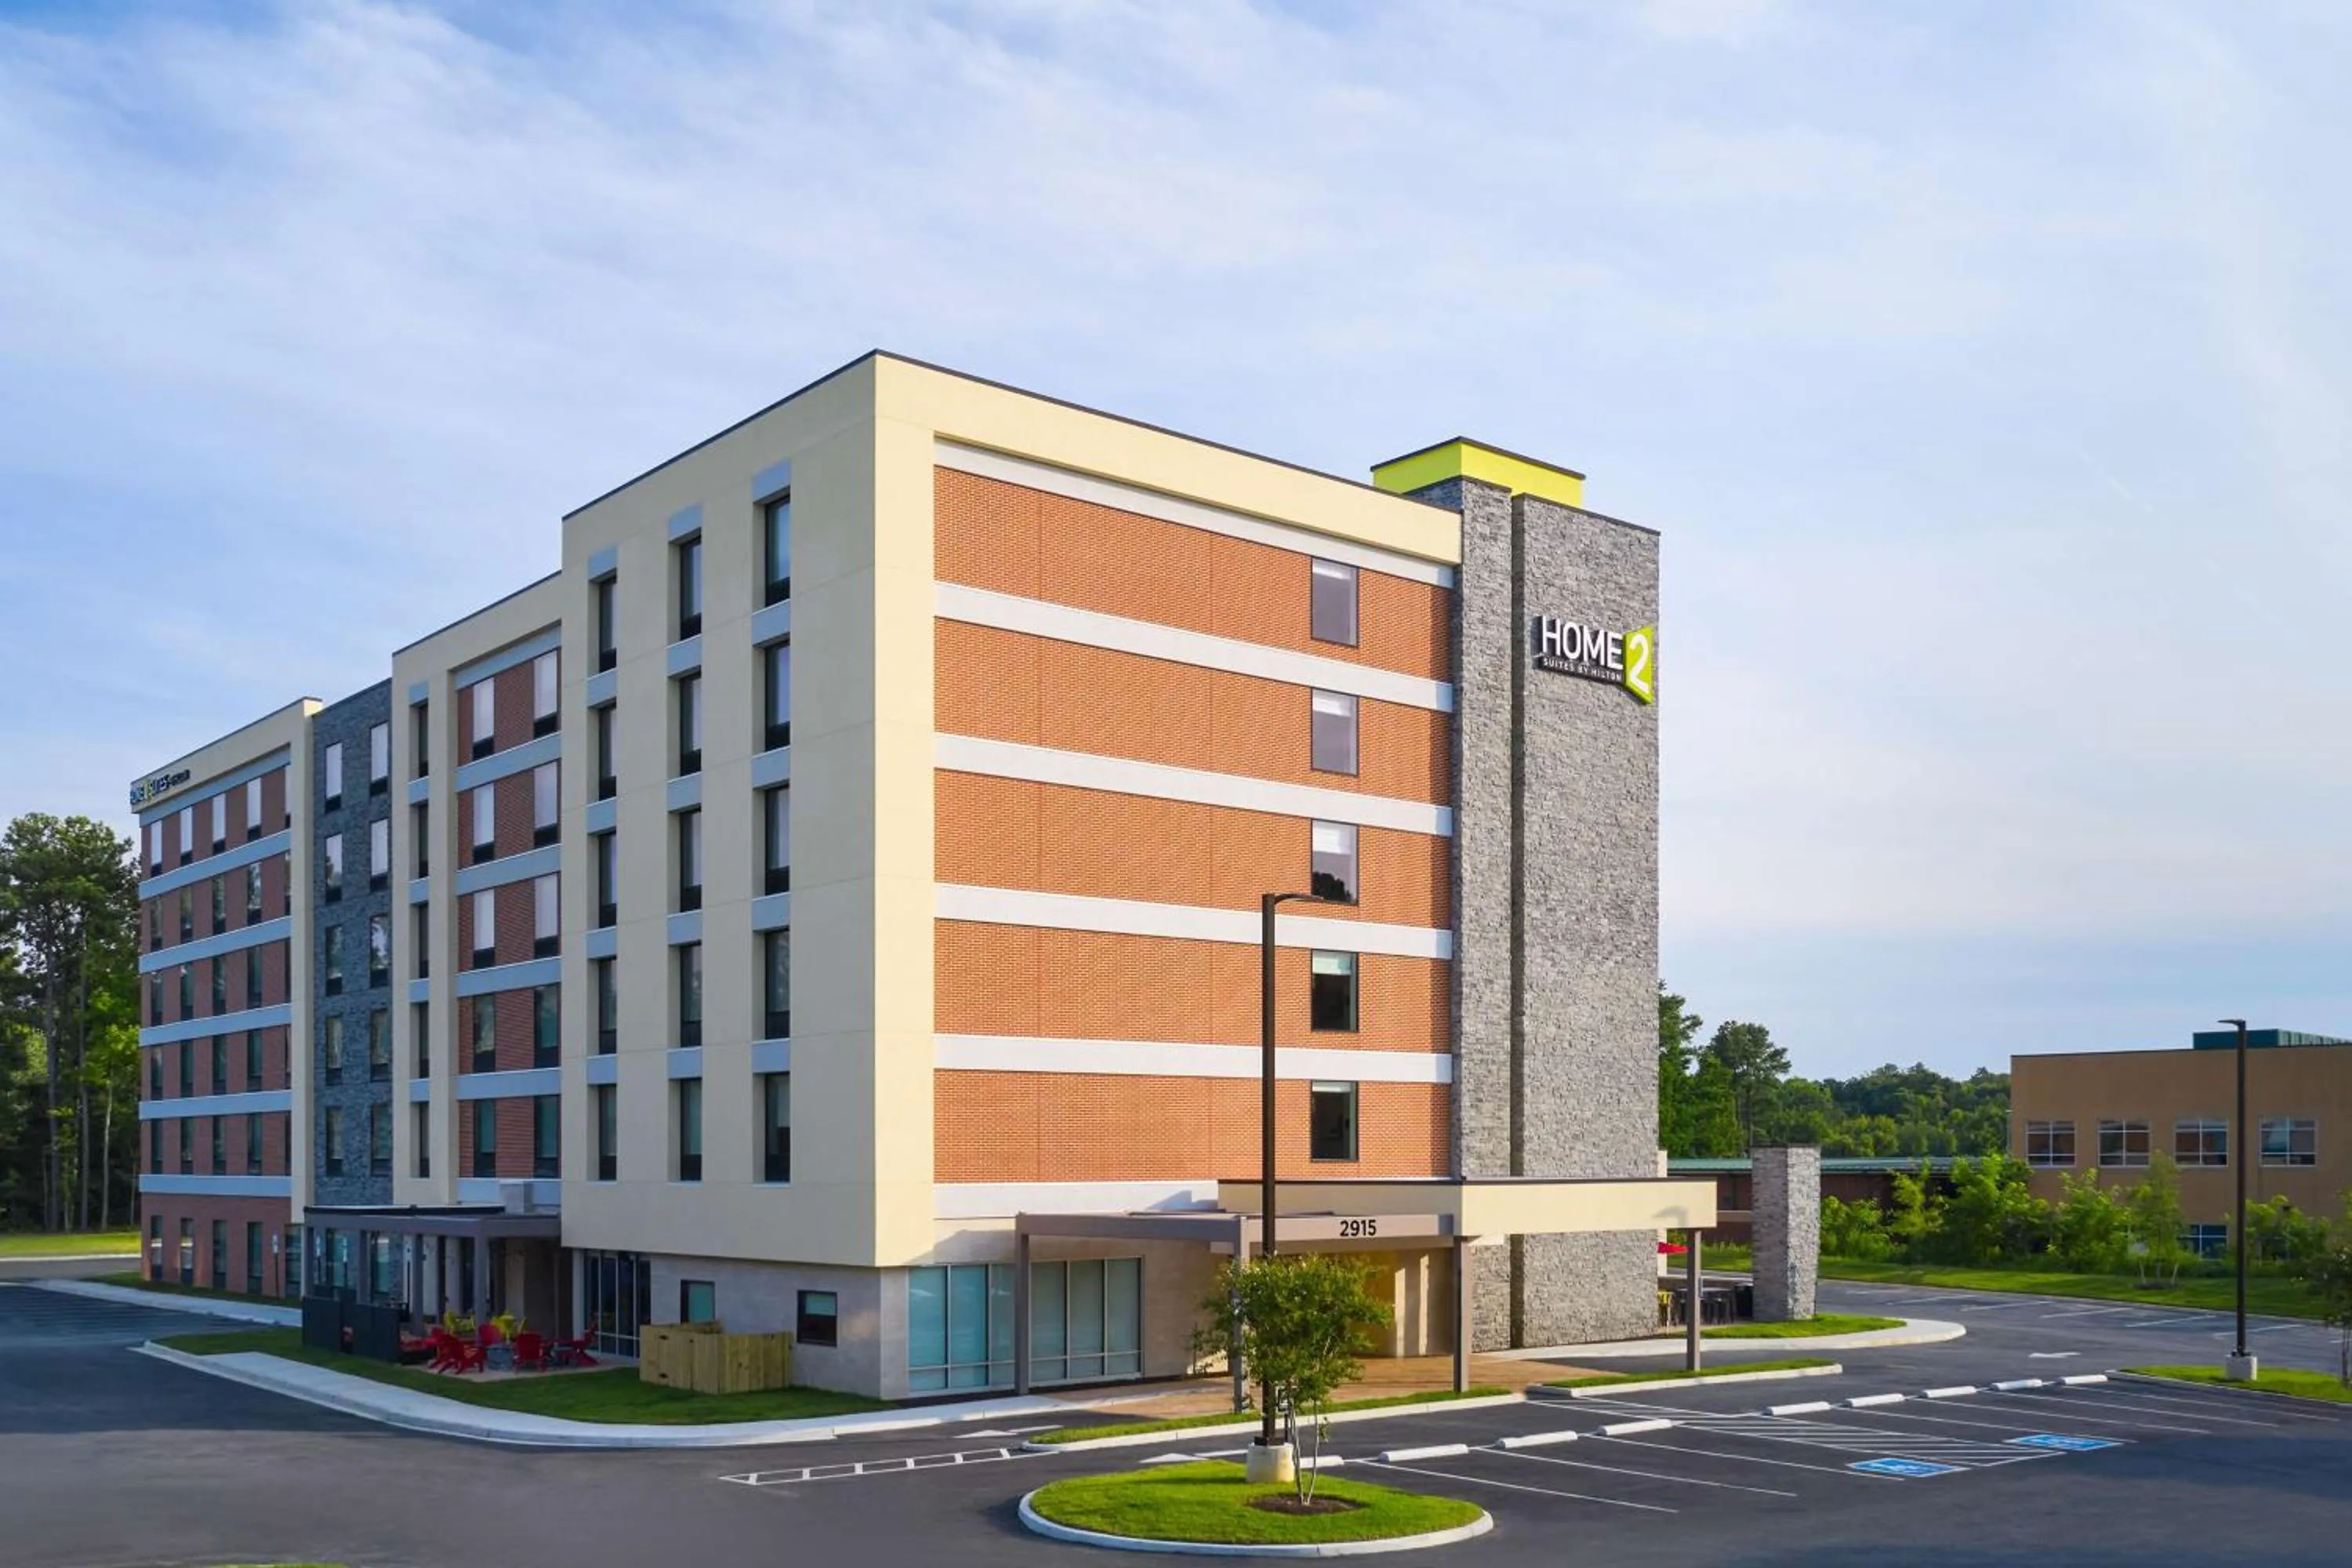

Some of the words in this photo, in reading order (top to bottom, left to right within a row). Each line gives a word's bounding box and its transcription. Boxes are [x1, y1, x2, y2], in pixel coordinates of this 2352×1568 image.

[1542, 615, 1624, 670] HOME
[1630, 633, 1650, 694] 2
[1543, 658, 1575, 672] SUITES
[1577, 665, 1589, 674] BY
[1591, 668, 1622, 681] HILTON
[1340, 1219, 1377, 1236] 2915
